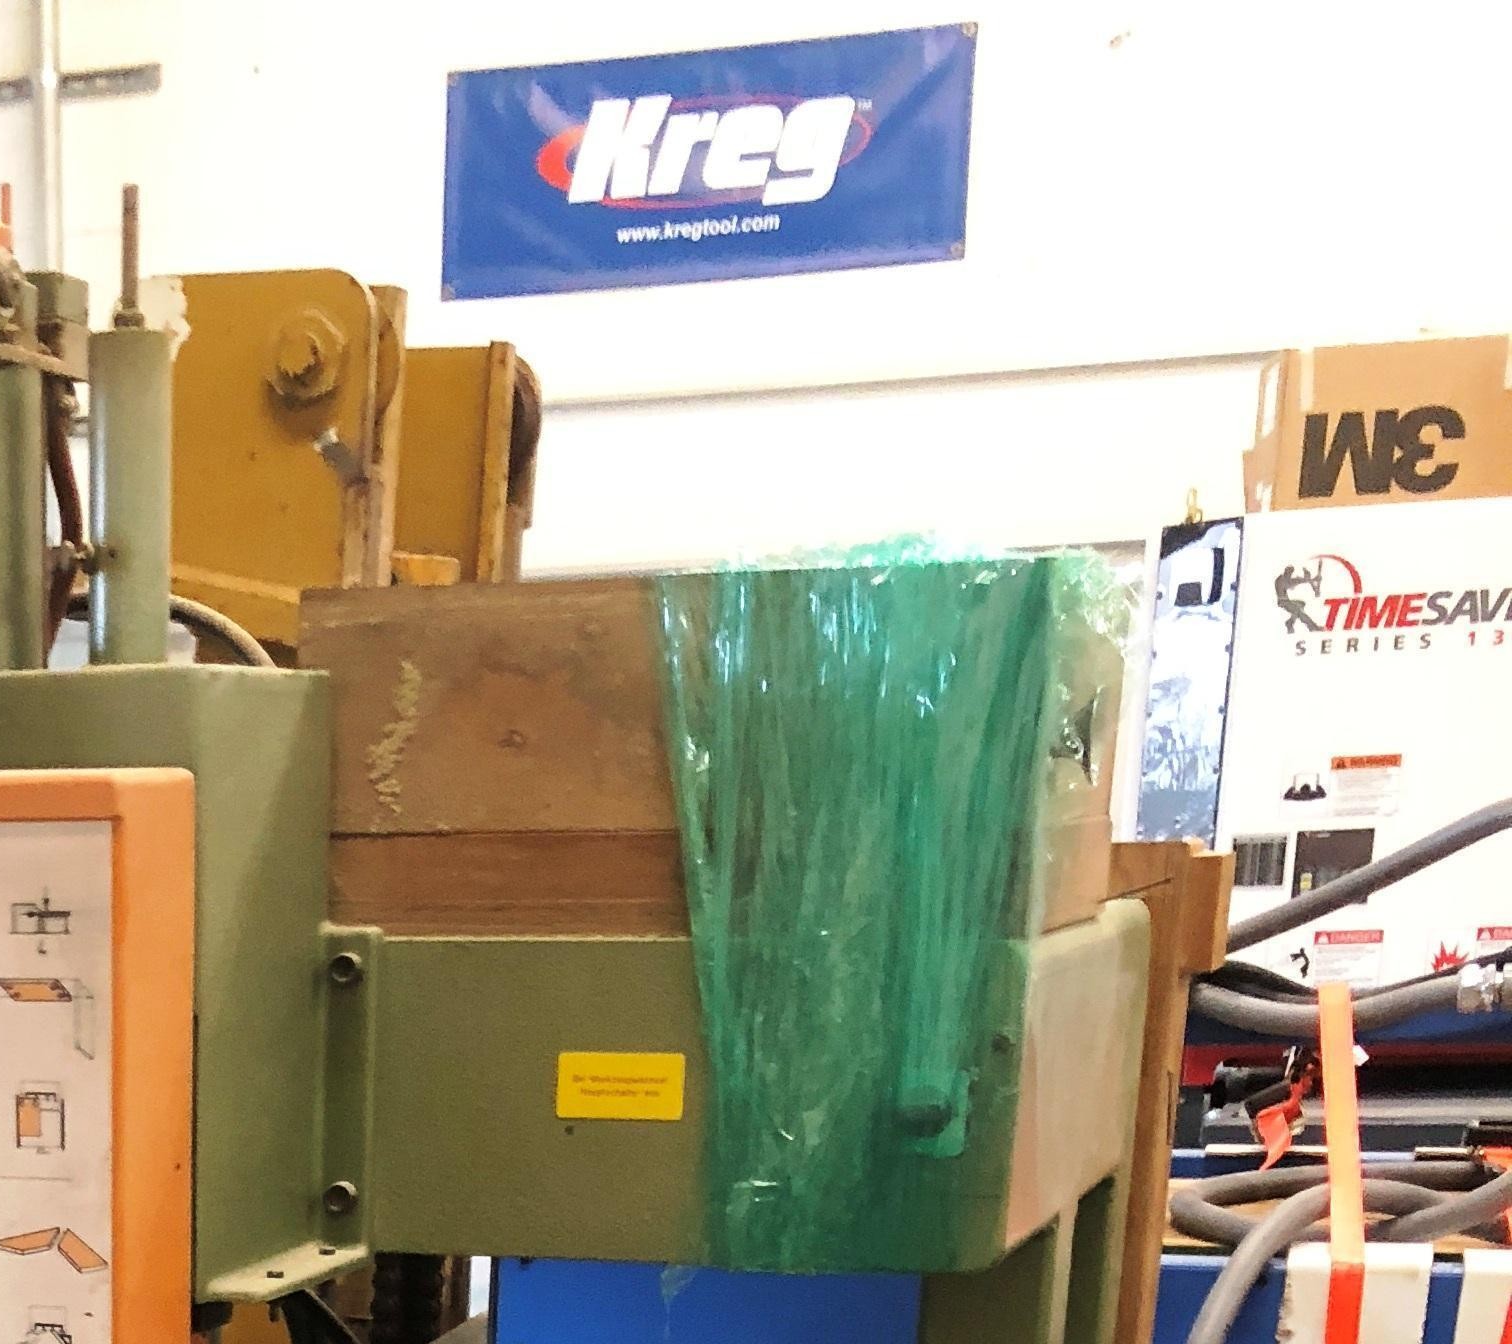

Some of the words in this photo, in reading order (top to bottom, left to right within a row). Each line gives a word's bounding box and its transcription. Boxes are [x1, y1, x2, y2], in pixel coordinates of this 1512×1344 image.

[568, 93, 855, 206] Kreg
[616, 214, 781, 244] www.kregtool.com
[1298, 404, 1465, 500] 3M
[1324, 587, 1512, 632] TIMESAV
[1295, 633, 1431, 657] SERIES
